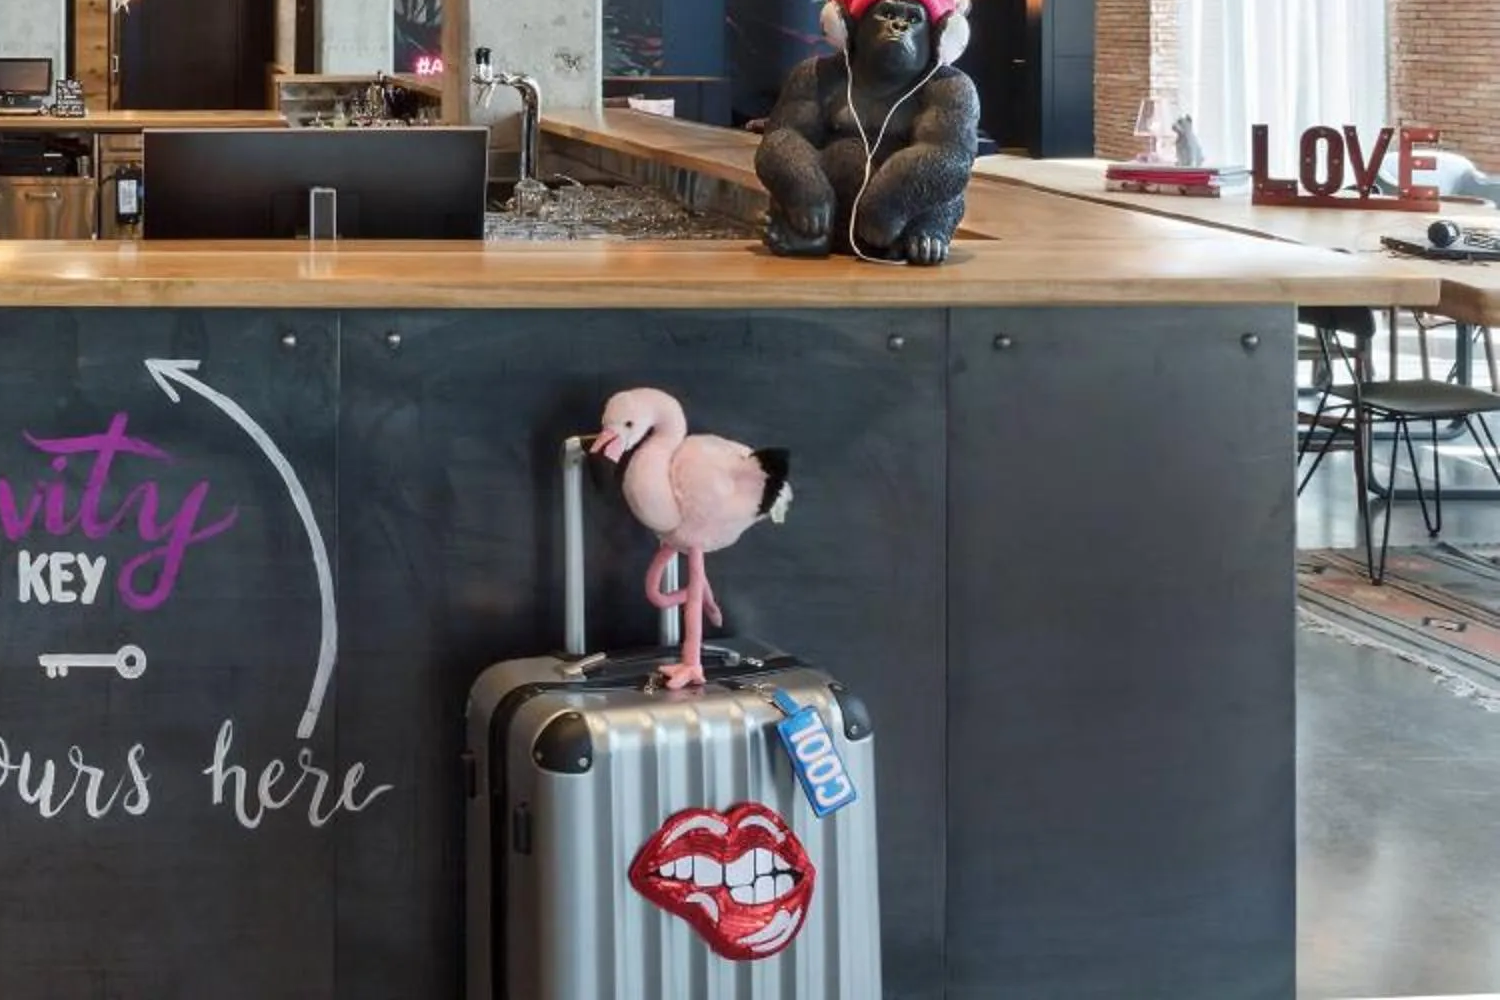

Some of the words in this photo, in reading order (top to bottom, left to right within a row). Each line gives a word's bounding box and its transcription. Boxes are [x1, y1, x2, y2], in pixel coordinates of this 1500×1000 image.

[1251, 123, 1440, 202] LOVE
[18, 550, 107, 605] KEY
[203, 718, 395, 829] here
[789, 710, 851, 808] COOL
